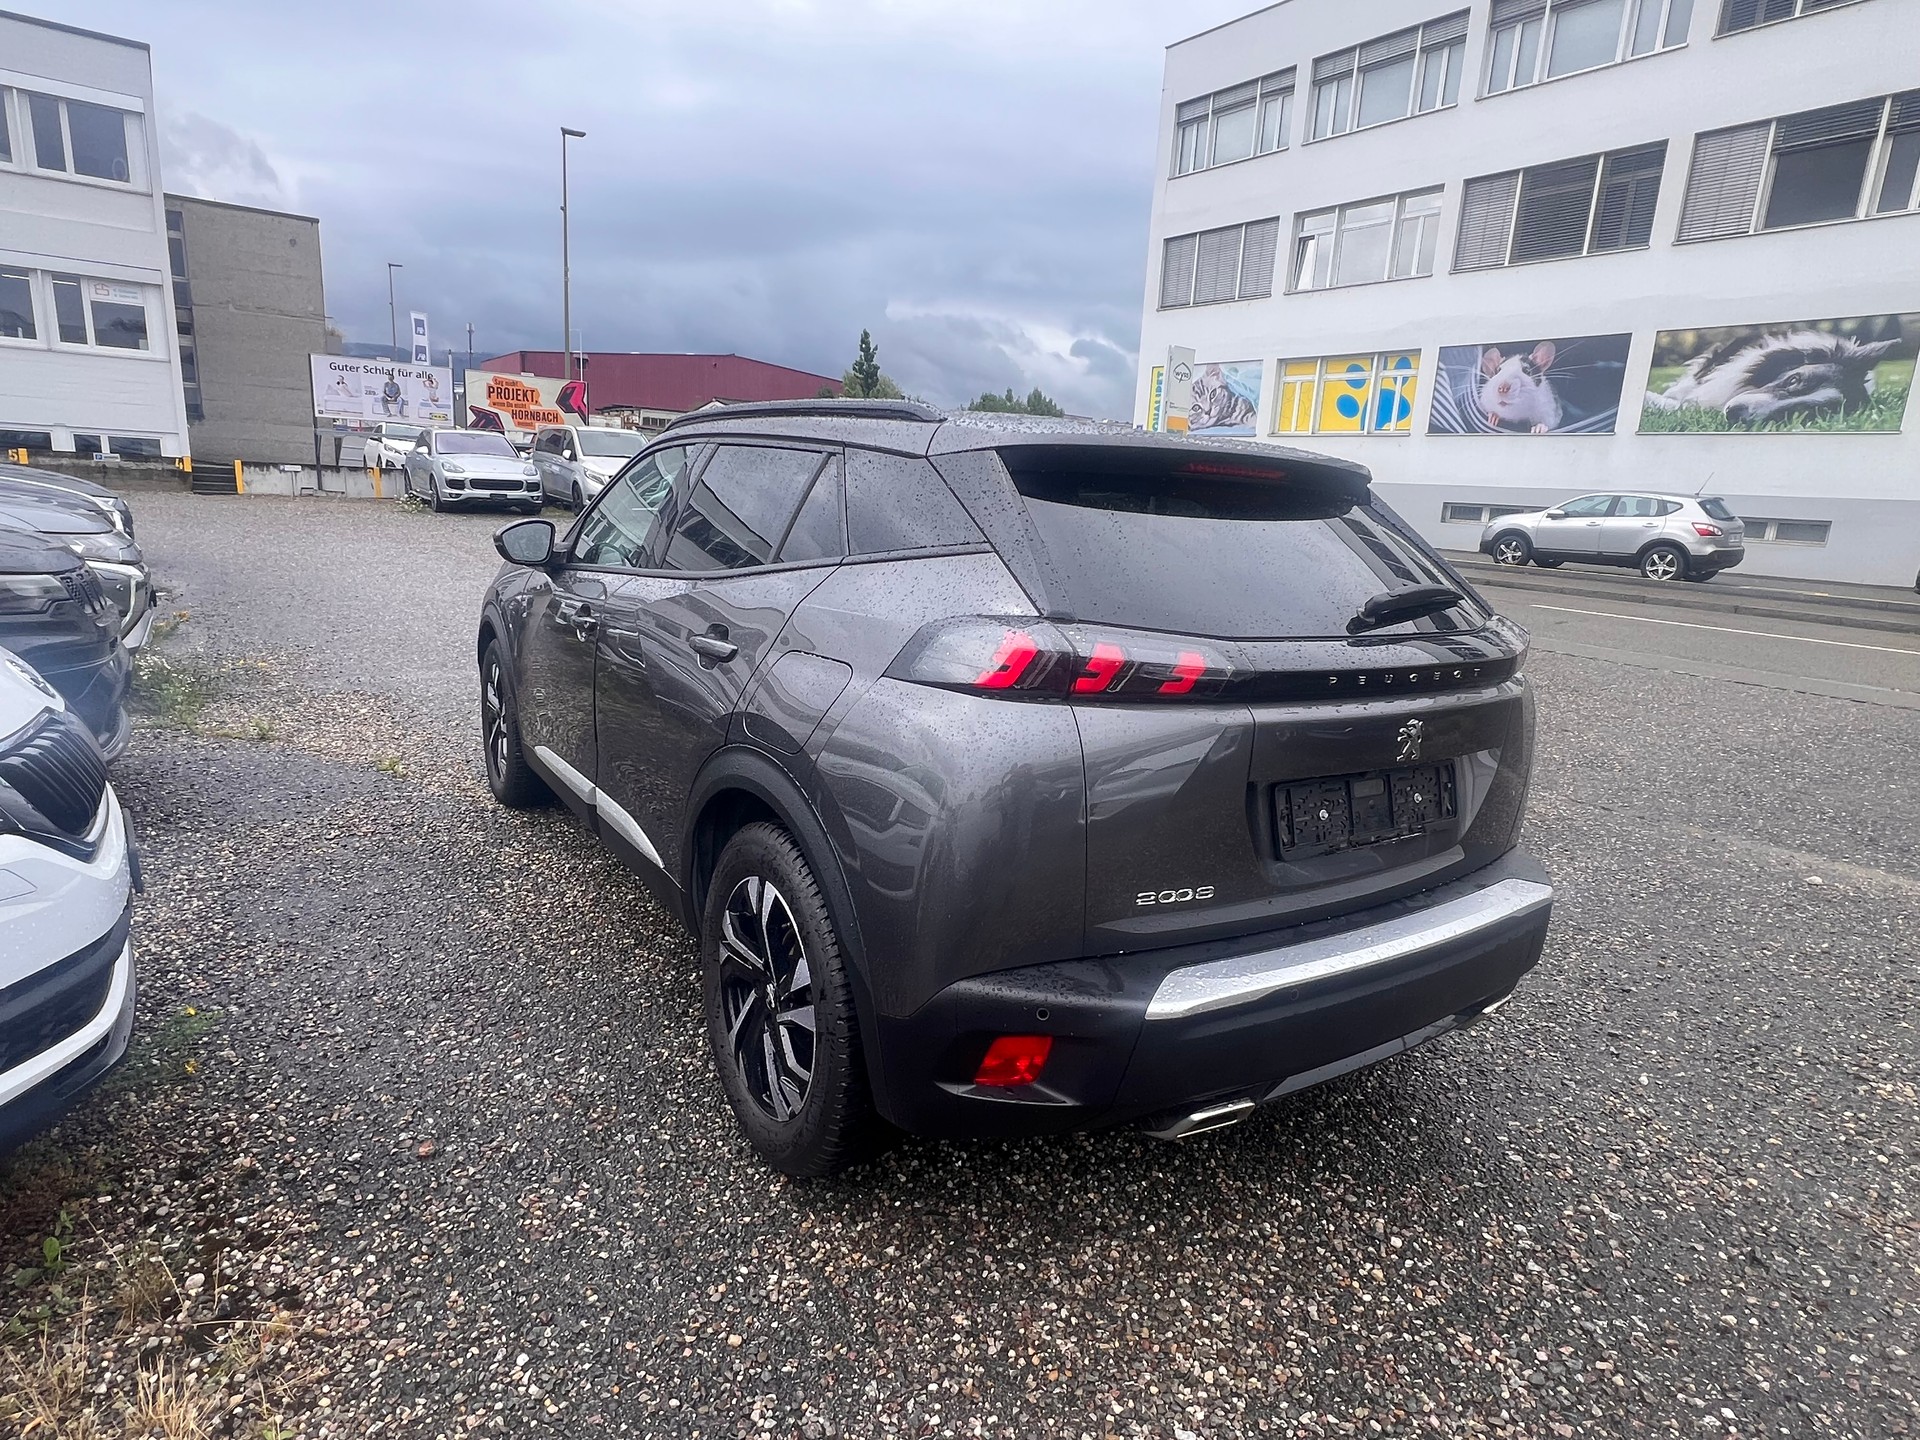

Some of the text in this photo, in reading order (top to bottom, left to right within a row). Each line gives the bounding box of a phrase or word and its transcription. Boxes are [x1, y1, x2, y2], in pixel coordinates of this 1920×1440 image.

[329, 362, 361, 373] Guter
[363, 365, 395, 376] Schlaf
[398, 368, 413, 378] für
[494, 378, 505, 387] Sag
[488, 386, 538, 404] PROJEKT,
[511, 409, 559, 423] HORNBACH
[8, 449, 18, 461] 5
[1329, 668, 1481, 685] PEUGEOT
[1136, 885, 1215, 905] 2008
